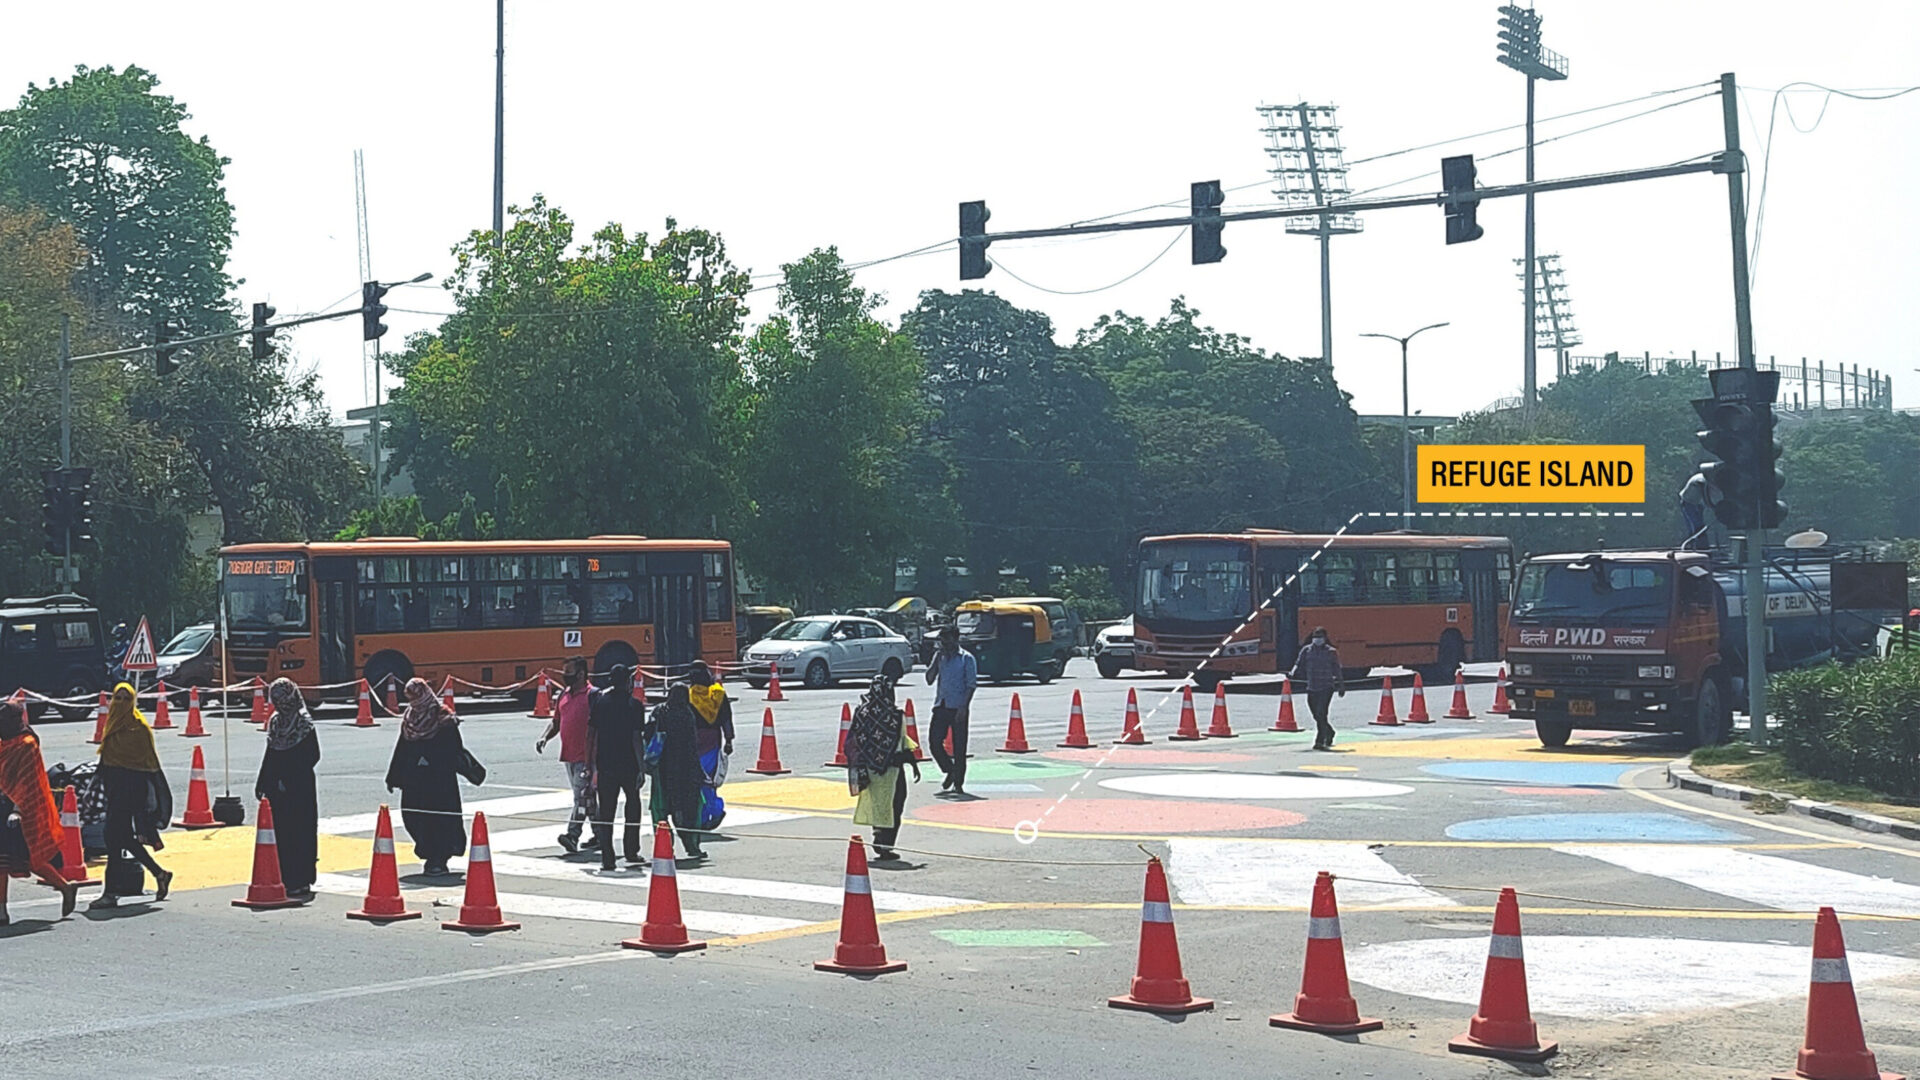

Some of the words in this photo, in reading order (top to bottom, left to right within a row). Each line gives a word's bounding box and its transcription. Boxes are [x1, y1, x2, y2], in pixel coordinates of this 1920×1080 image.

[254, 560, 273, 574] GATE
[274, 560, 295, 574] TERM
[1769, 597, 1780, 611] OF
[1784, 595, 1808, 610] DELHI
[1520, 629, 1549, 647] दिल्ली
[1612, 635, 1647, 647] सरकार
